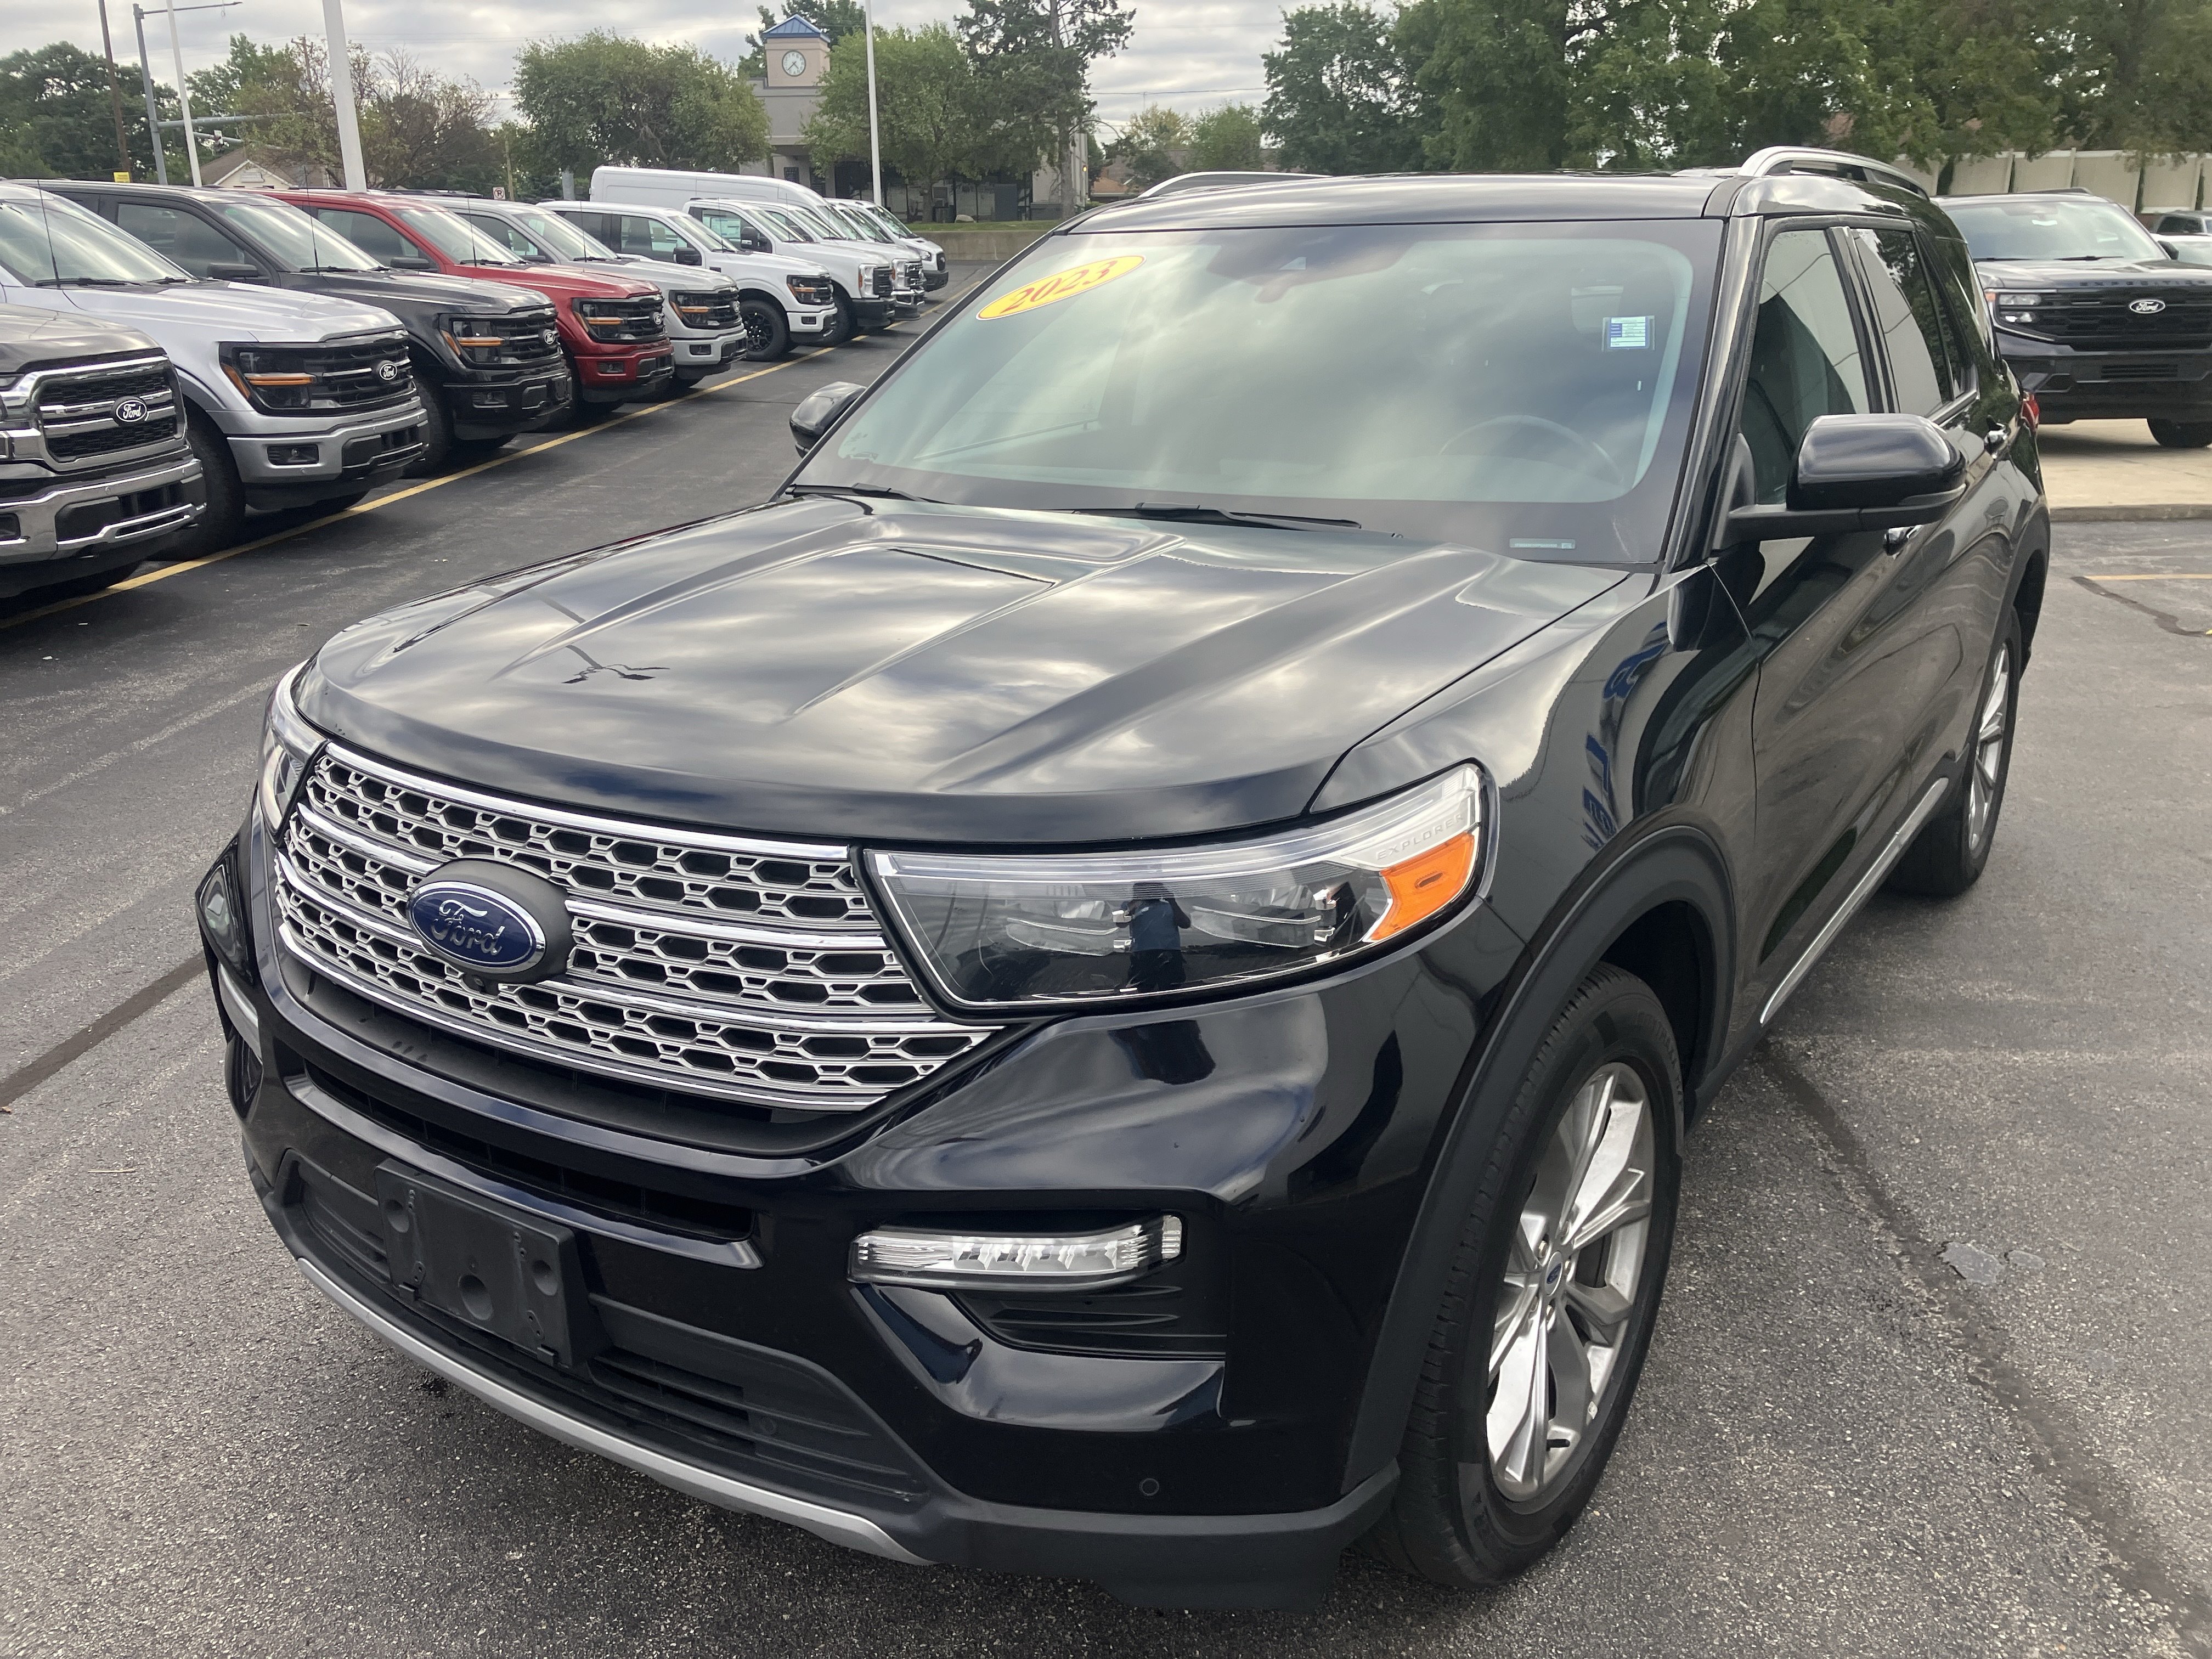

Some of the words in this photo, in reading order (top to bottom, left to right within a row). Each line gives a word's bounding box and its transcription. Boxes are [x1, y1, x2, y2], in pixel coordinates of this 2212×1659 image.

[1000, 260, 1118, 314] 2023
[2135, 301, 2159, 312] Ford
[123, 403, 142, 419] Ford
[1376, 813, 1464, 860] EXPLORER
[431, 899, 505, 956] Ford
